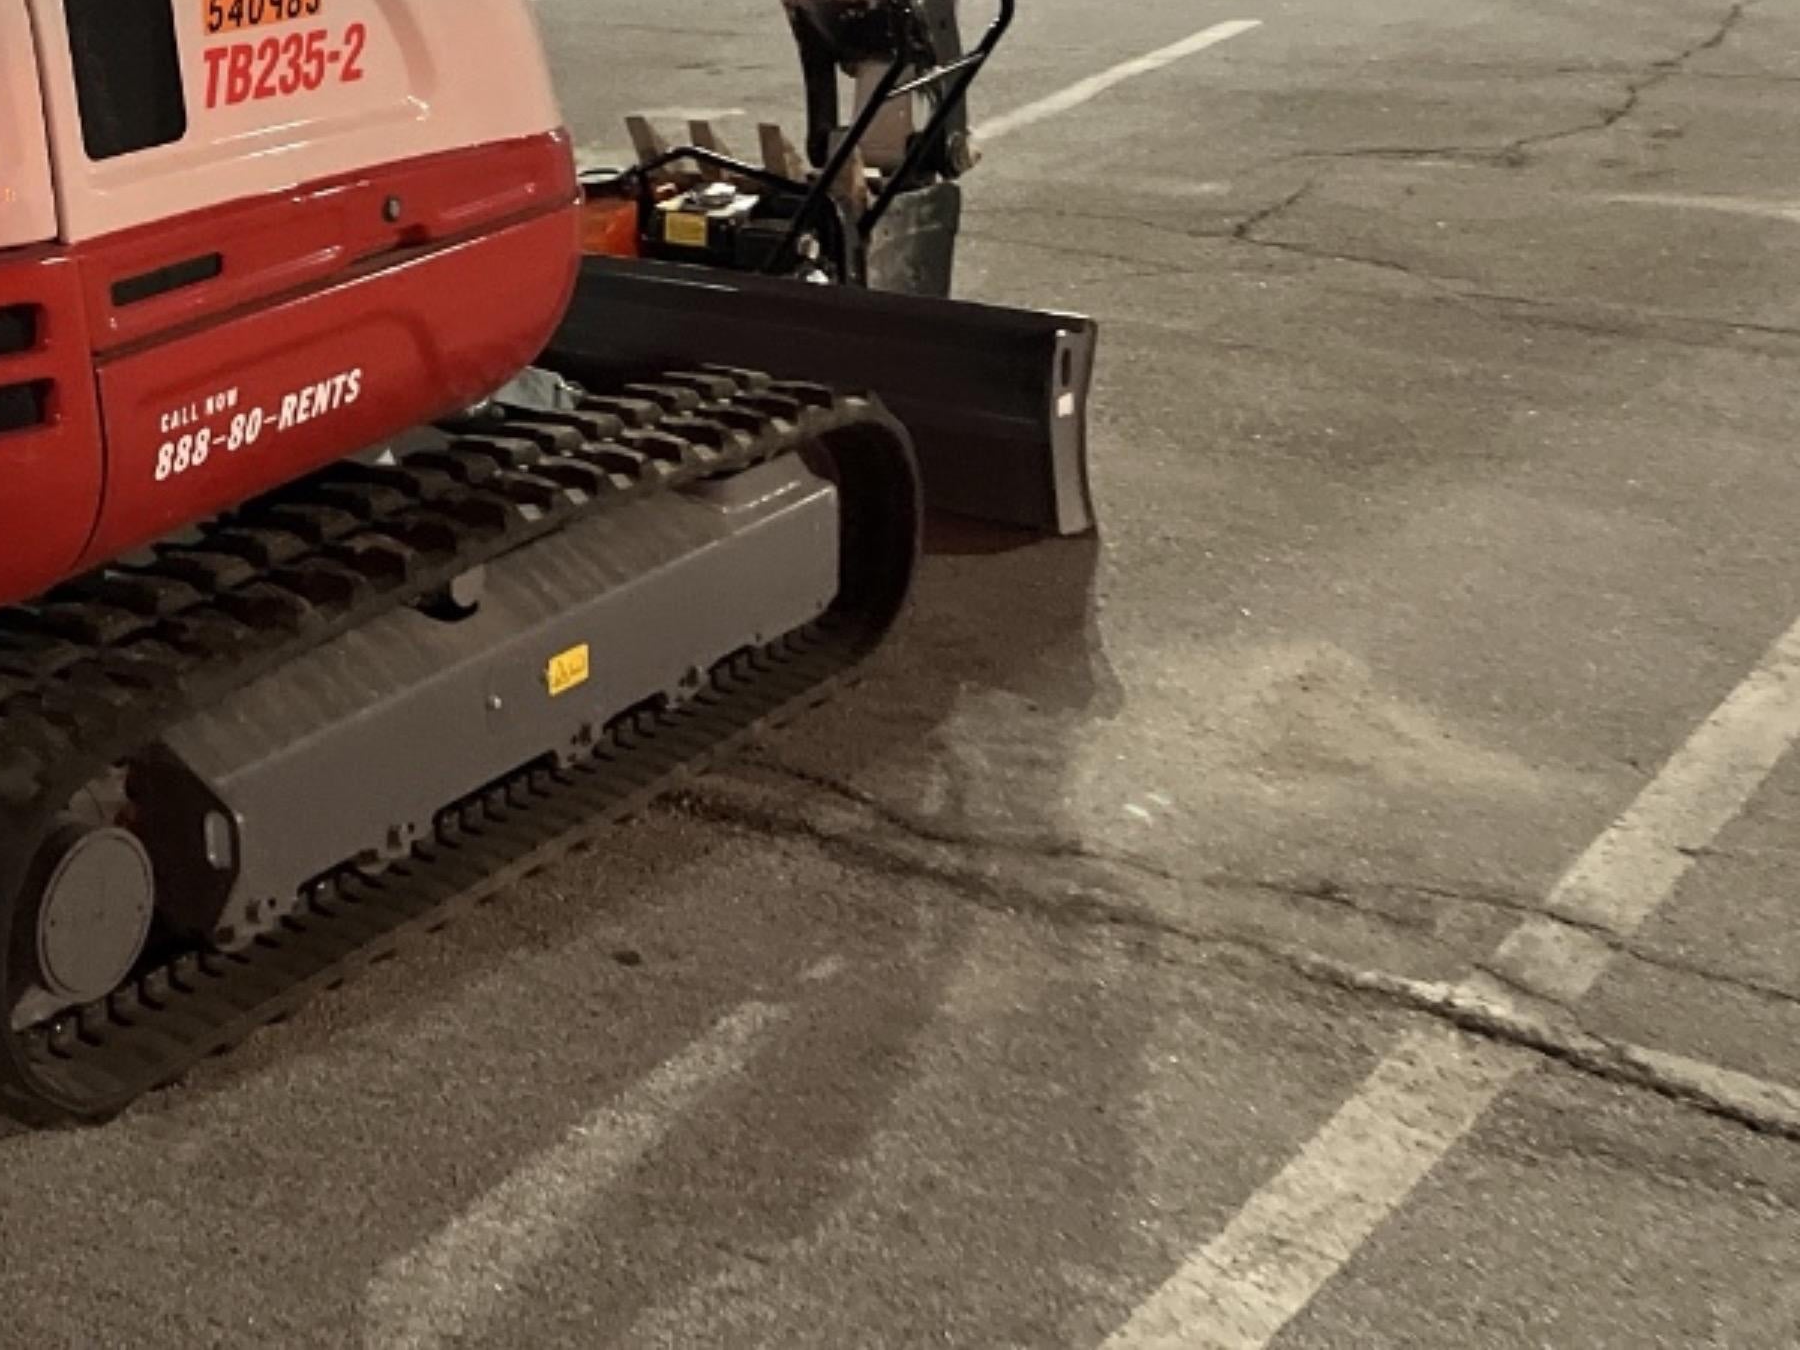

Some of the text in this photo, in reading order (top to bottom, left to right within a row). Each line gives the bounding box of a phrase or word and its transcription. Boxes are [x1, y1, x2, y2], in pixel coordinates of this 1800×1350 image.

[203, 22, 366, 110] TB235-2
[155, 367, 363, 482] 888-80-RENTS
[161, 386, 239, 434] CALL NOW
